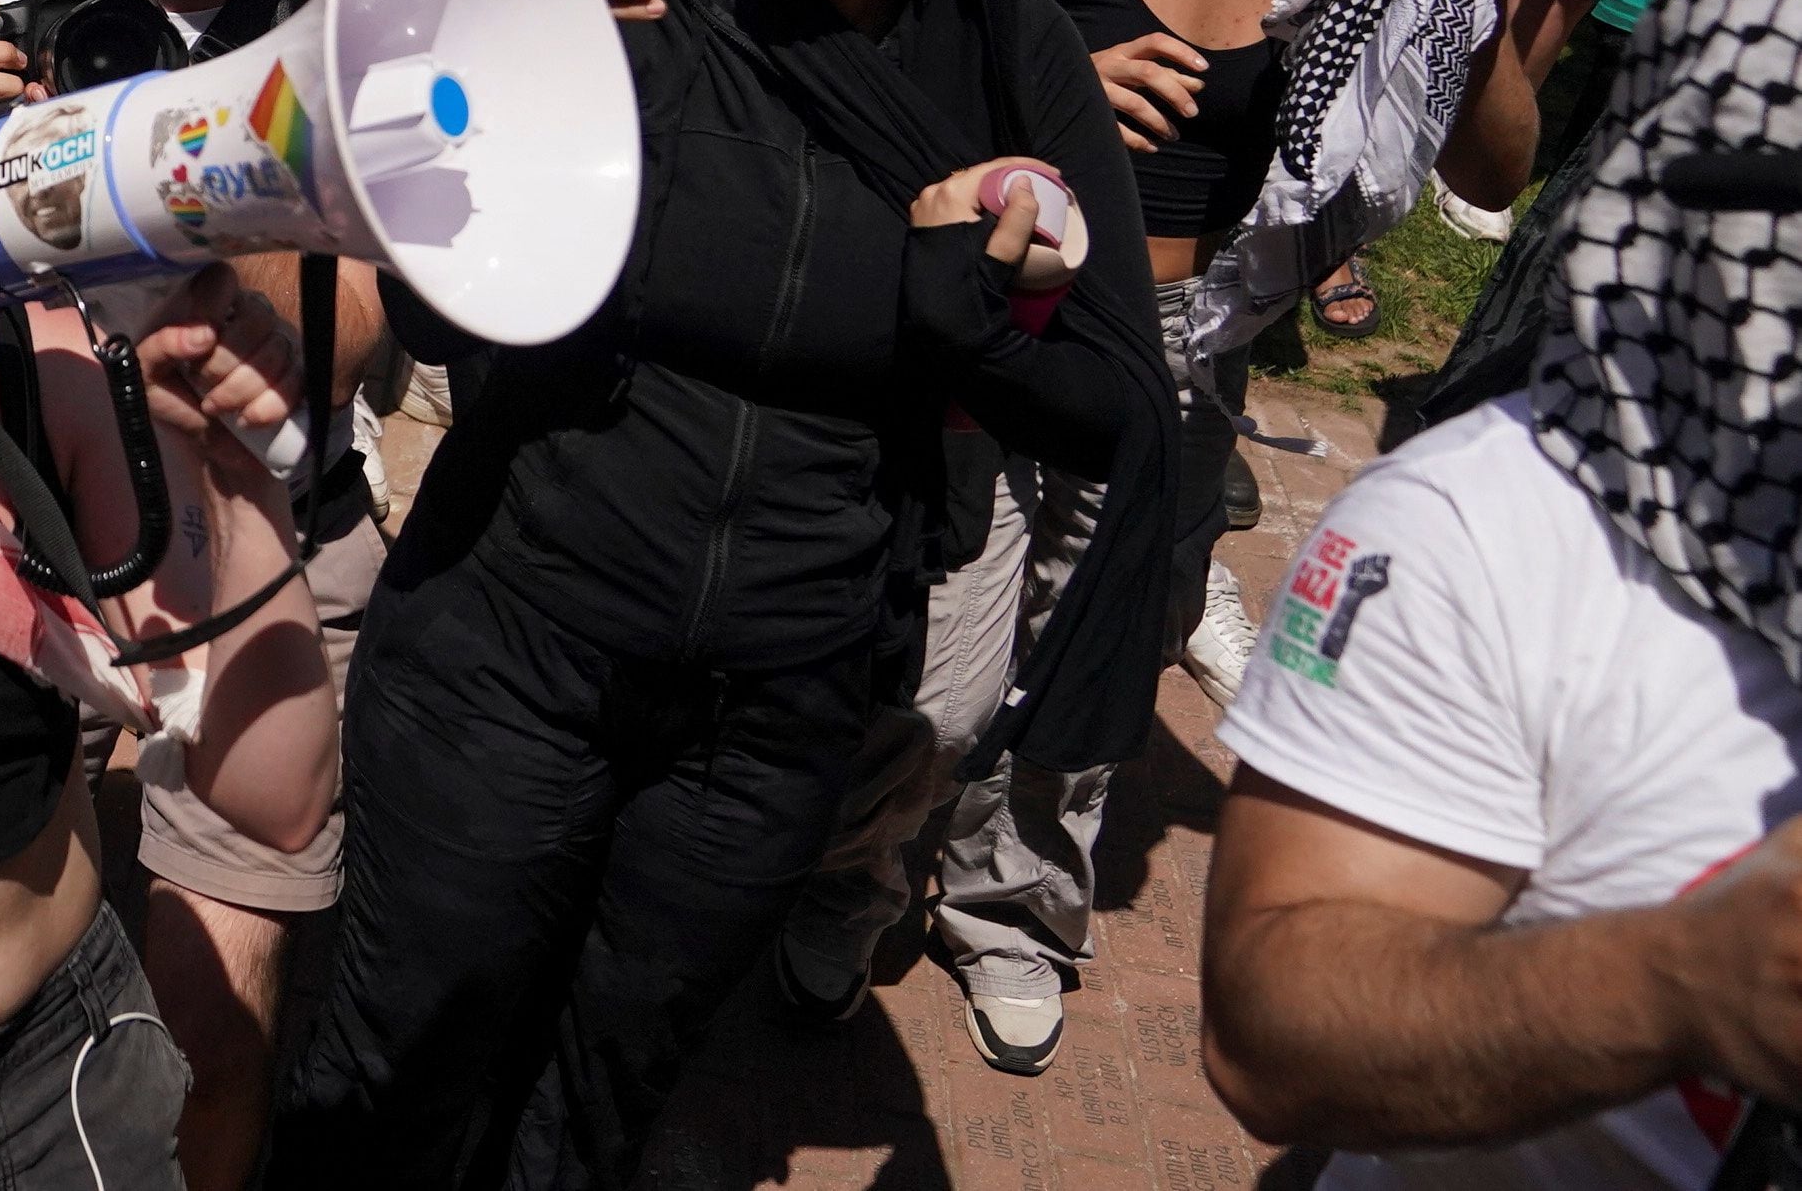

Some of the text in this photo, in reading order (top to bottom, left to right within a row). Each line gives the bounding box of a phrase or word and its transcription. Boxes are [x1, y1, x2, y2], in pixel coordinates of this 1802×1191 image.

[1137, 1018, 1163, 1063] SUSAN
[1054, 1076, 1076, 1101] KIP
[1098, 1054, 1122, 1091] 2004
[1012, 1090, 1036, 1129] 2004
[965, 1114, 988, 1150] PING
[989, 1114, 1014, 1160] WANG
[1213, 1144, 1241, 1185] 2004
